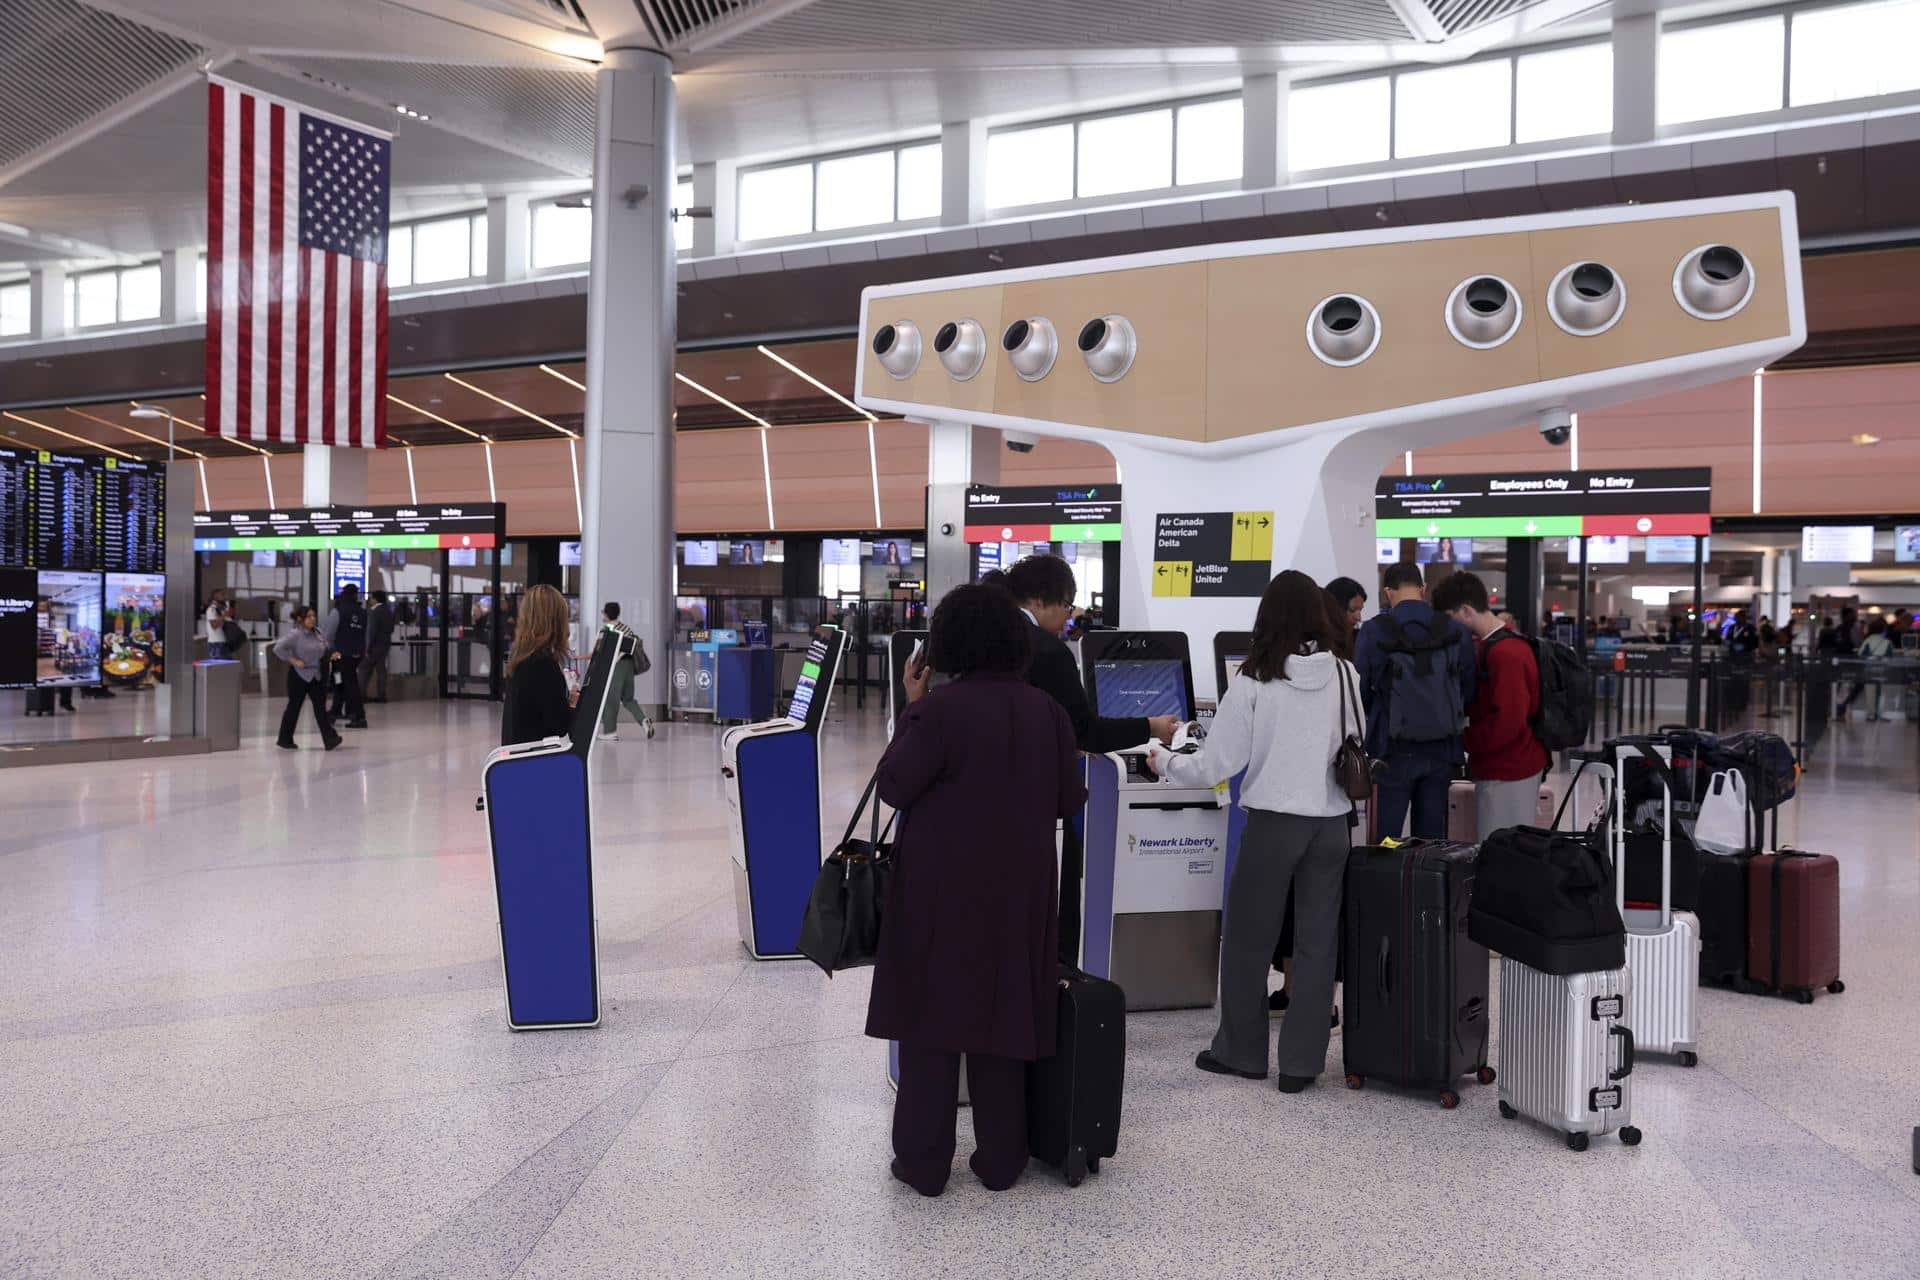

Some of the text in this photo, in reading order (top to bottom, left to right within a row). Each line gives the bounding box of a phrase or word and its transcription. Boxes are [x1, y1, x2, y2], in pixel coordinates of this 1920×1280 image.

[1395, 483, 1413, 491] TSA
[1490, 478, 1569, 491] Employees Only
[1589, 477, 1634, 488] No Entry
[970, 493, 1000, 504] No Entry
[1057, 491, 1072, 499] TSA
[1159, 518, 1204, 526] Air Canada
[1159, 529, 1198, 537] American
[1158, 539, 1180, 547] Delta
[1195, 564, 1229, 573] JetBlue
[1195, 575, 1223, 584] United
[1139, 837, 1215, 847] Newark Liberty
[1139, 847, 1204, 856] International Airport
